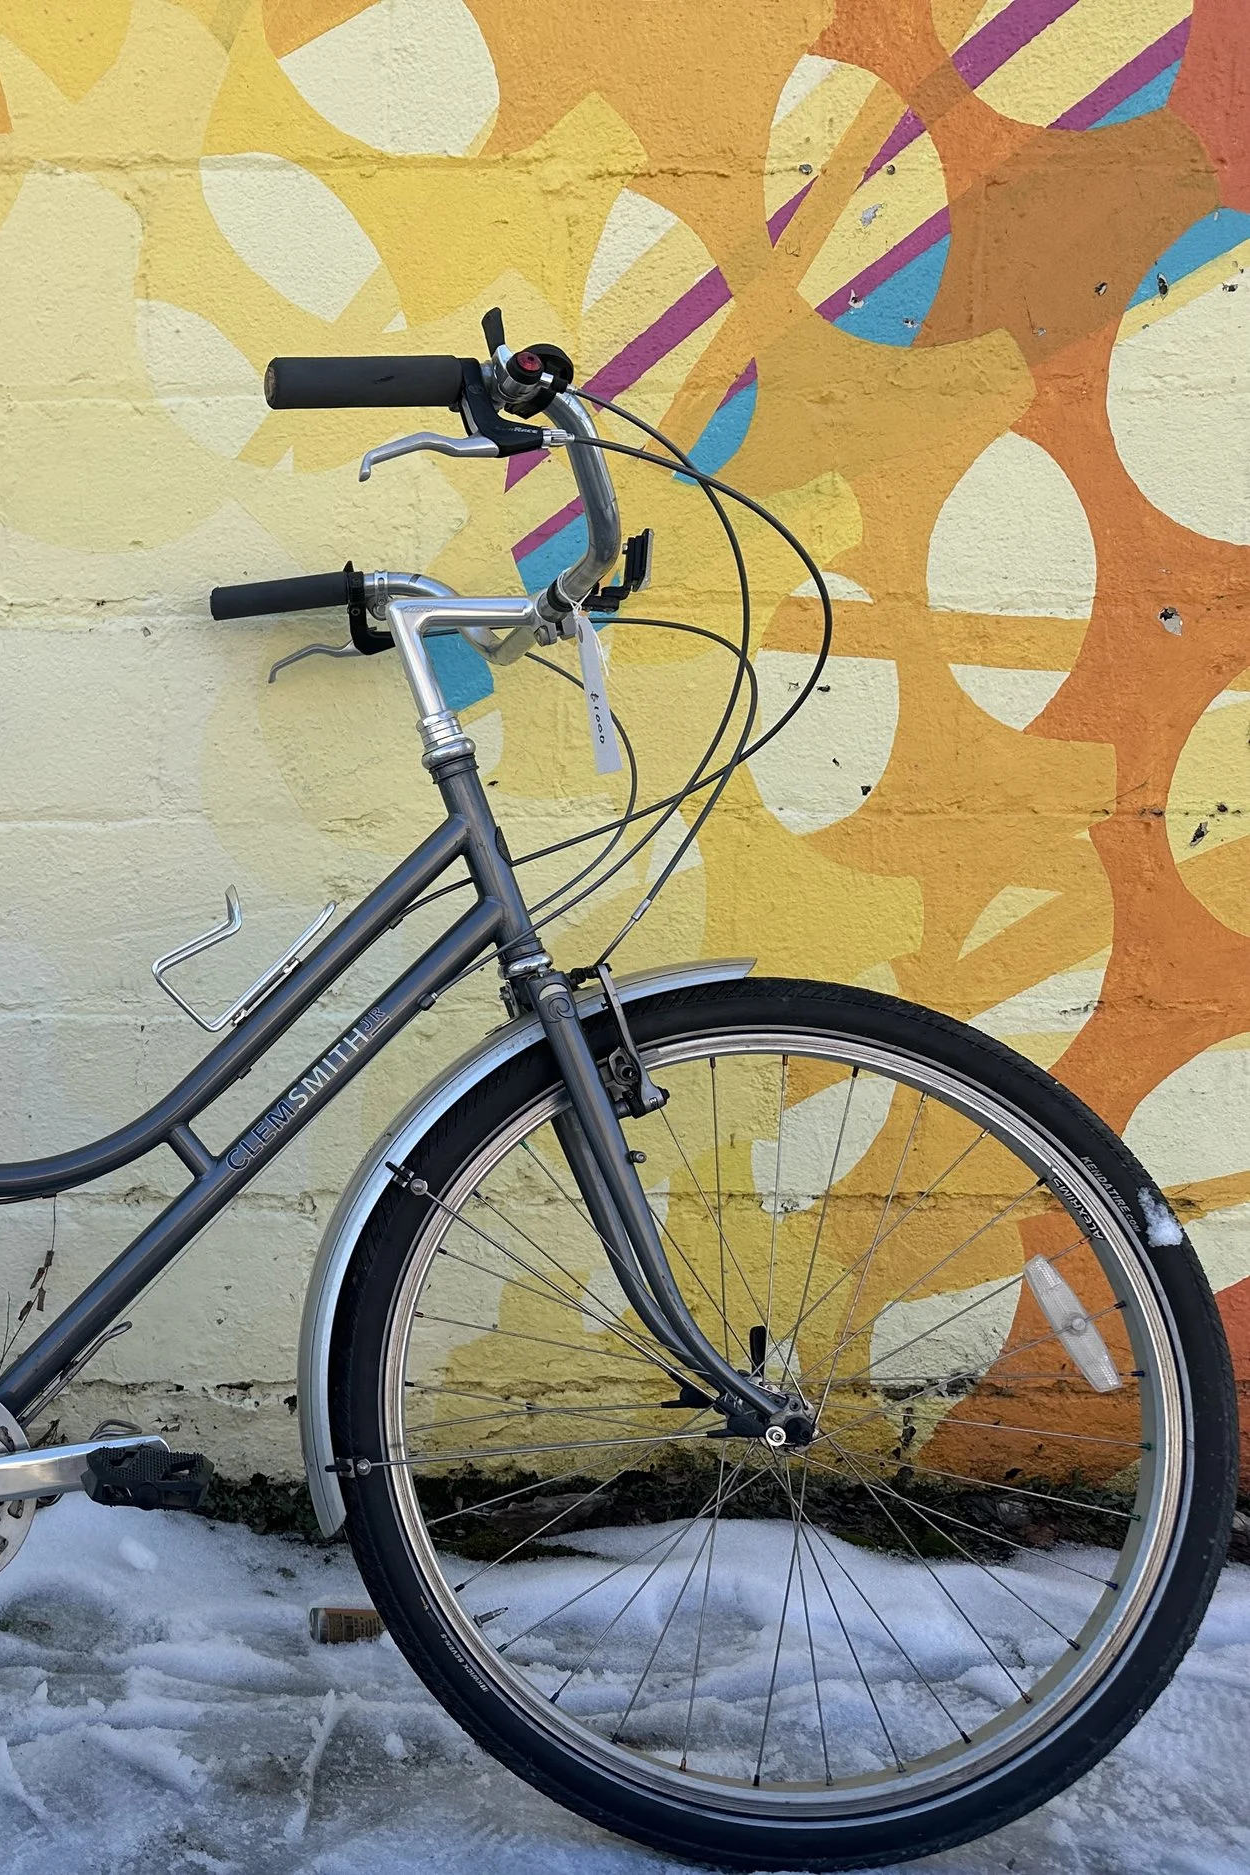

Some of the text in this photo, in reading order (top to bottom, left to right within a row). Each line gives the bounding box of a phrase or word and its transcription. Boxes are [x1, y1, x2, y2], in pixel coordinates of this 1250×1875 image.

[360, 1006, 385, 1031] JR
[1053, 1178, 1104, 1240] ALEXRIMS
[1080, 1156, 1141, 1232] KENDATIRE.COM
